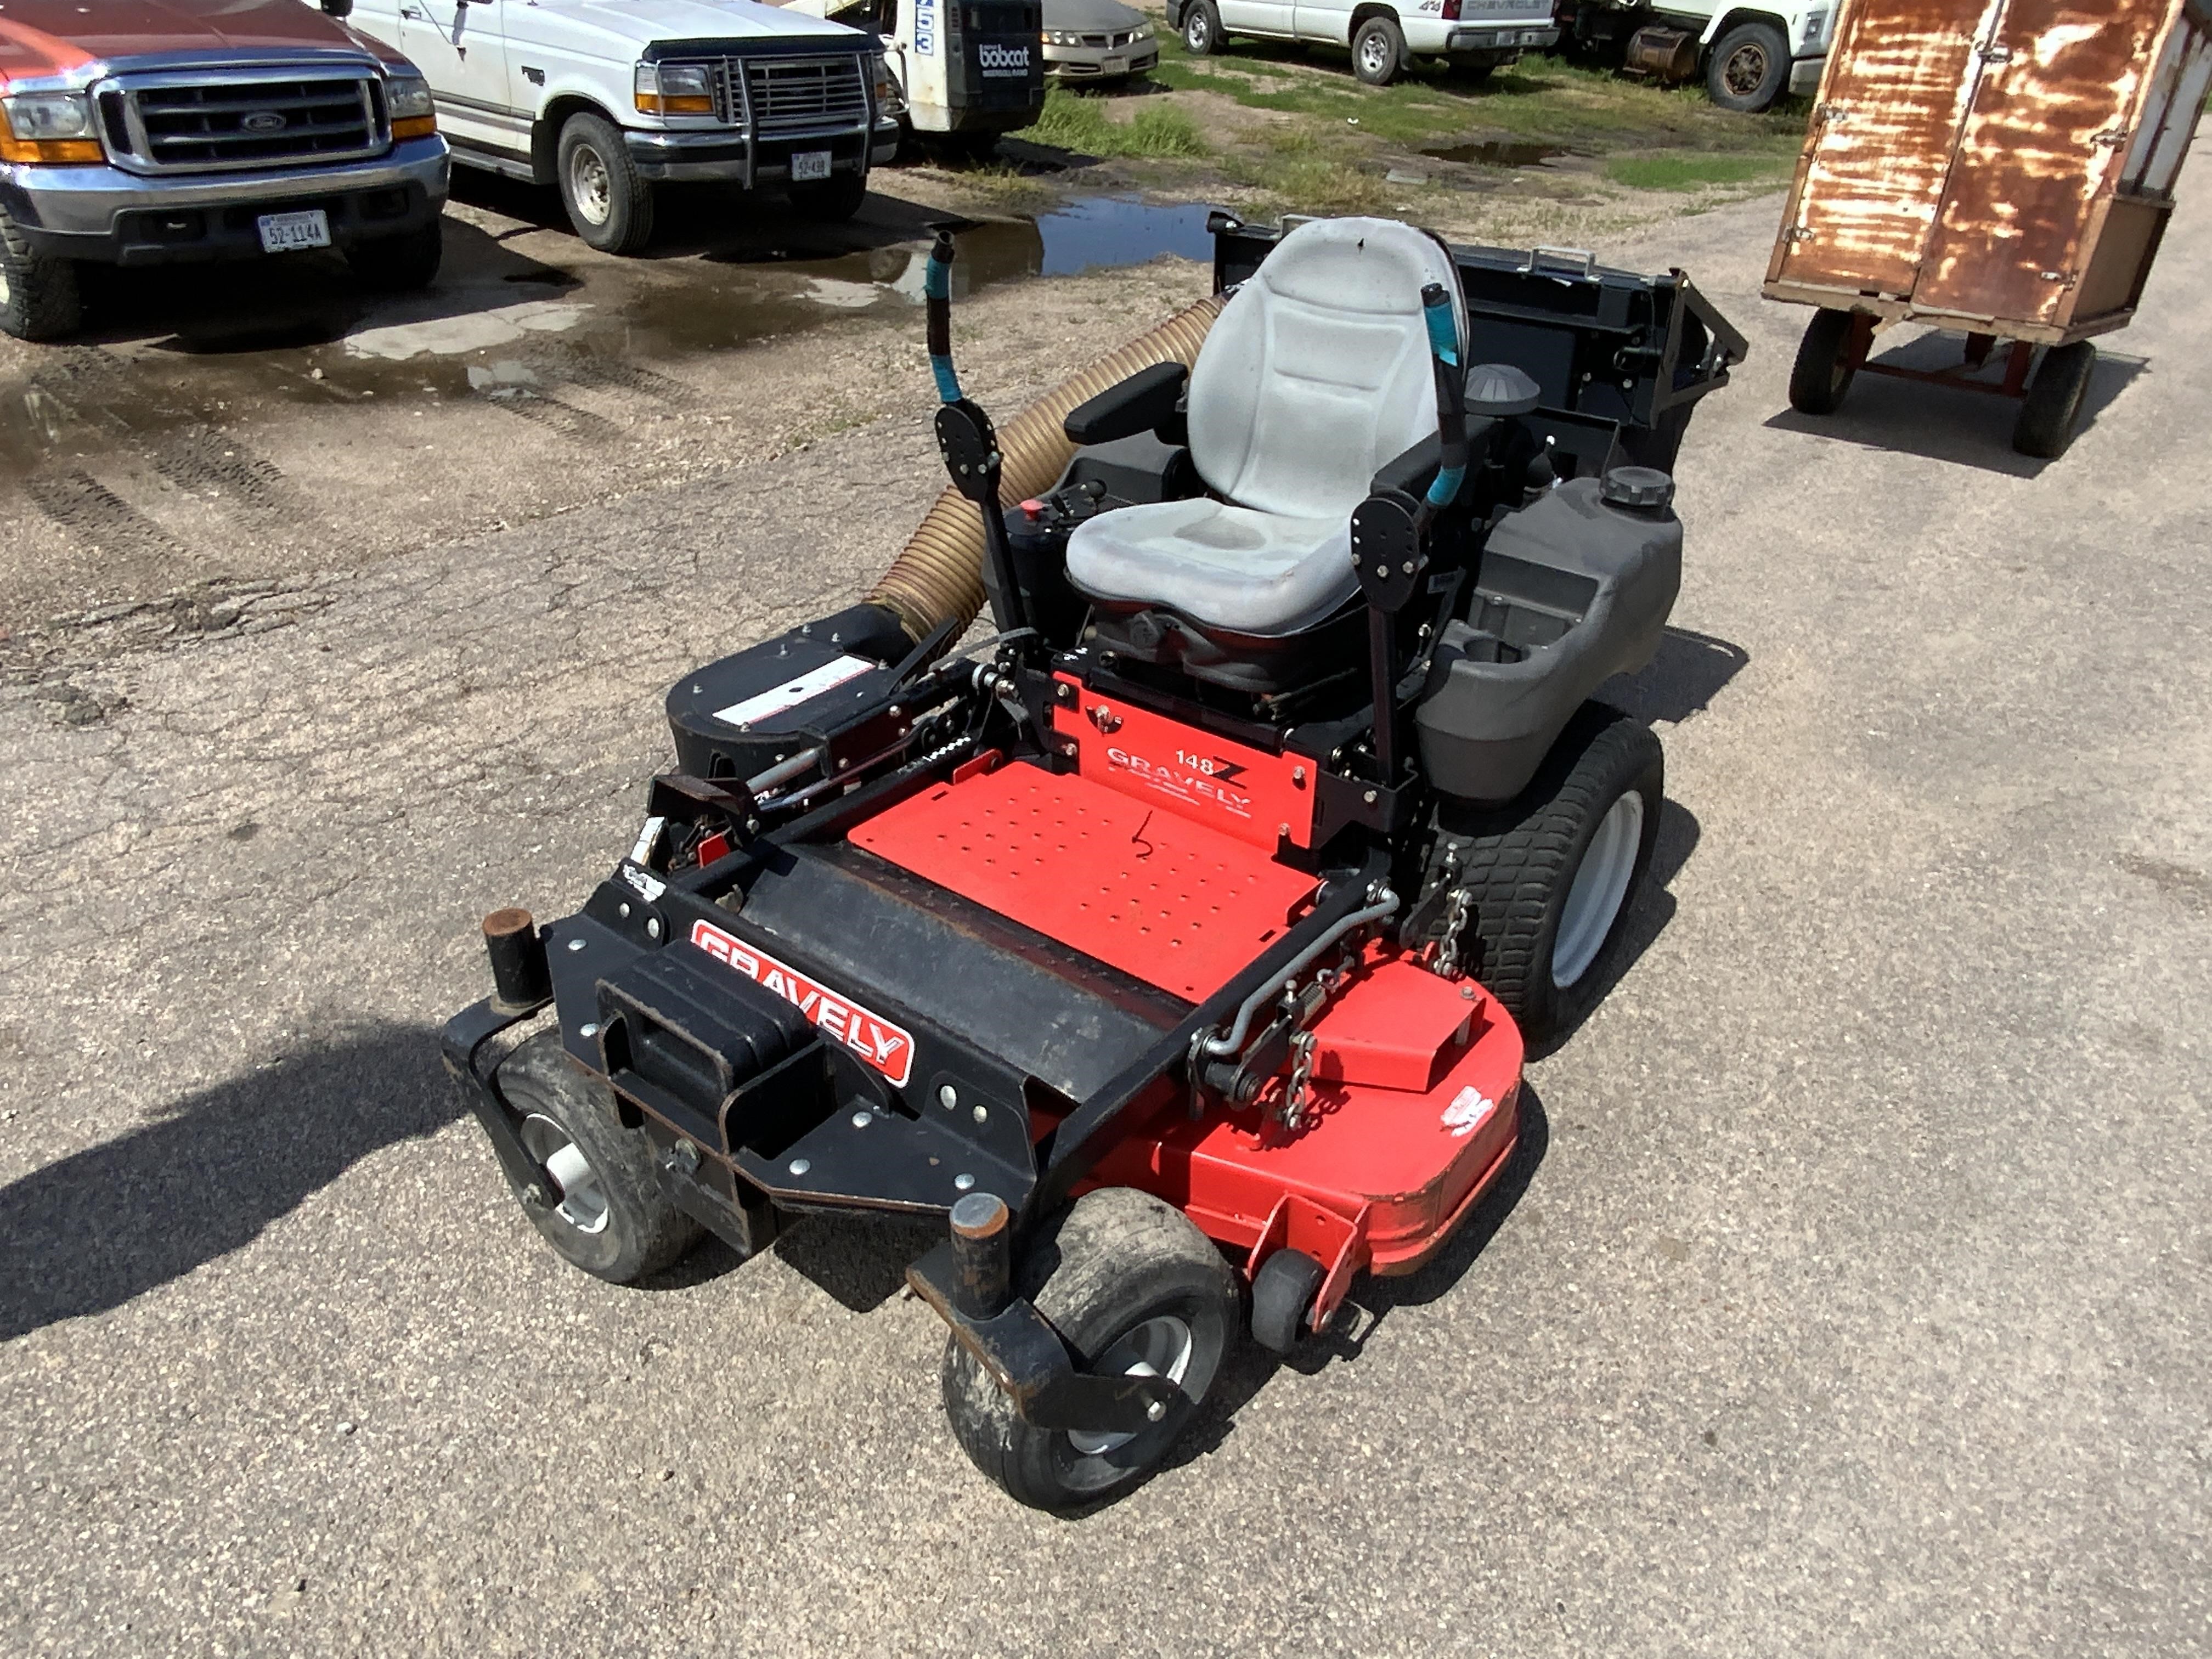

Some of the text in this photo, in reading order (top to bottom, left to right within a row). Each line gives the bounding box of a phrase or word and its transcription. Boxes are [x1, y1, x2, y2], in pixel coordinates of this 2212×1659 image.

[917, 0, 933, 55] 53
[979, 44, 1029, 67] bobcat
[269, 223, 323, 245] 52-114A
[1107, 747, 1252, 810] GRAVELY
[700, 931, 905, 1065] GRAVELY
